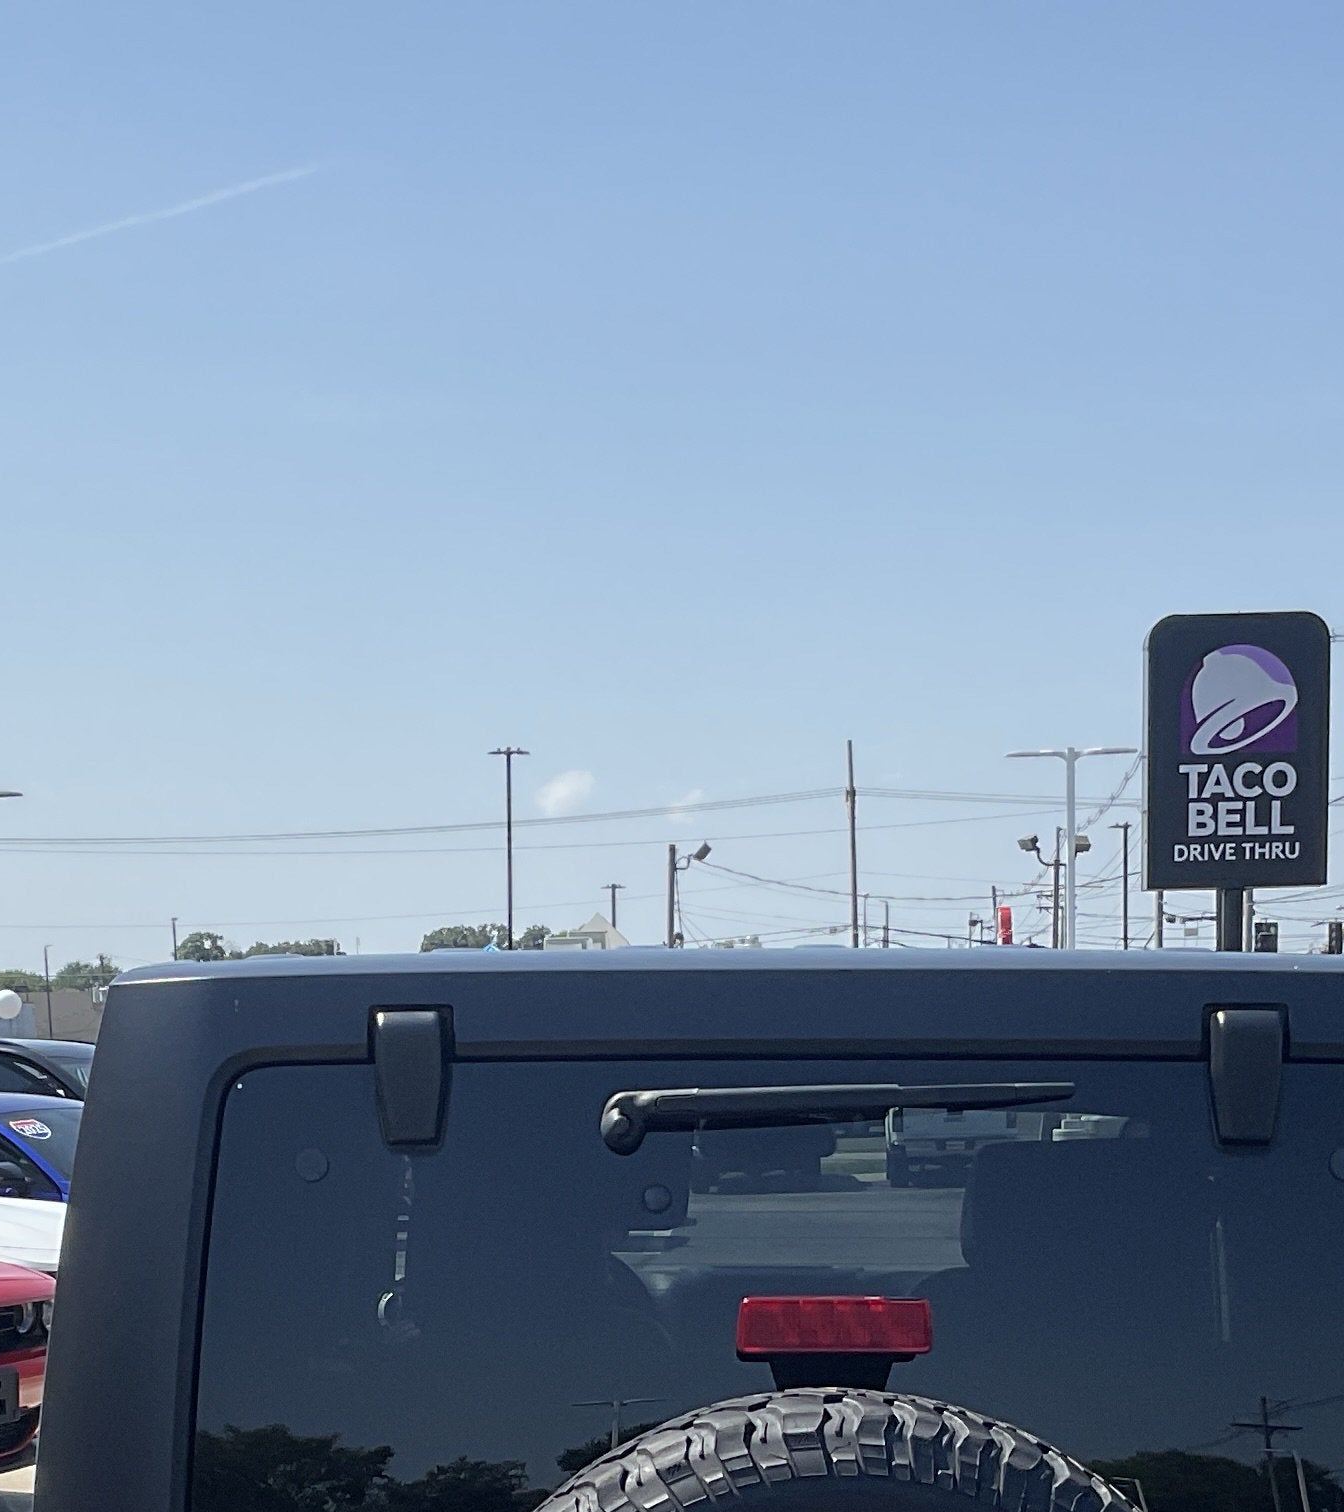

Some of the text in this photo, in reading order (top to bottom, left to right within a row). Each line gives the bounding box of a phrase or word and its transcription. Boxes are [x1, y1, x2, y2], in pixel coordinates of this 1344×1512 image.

[1178, 762, 1298, 799] TACO
[1187, 800, 1295, 837] BELL
[1173, 841, 1301, 862] DRIVE THRU
